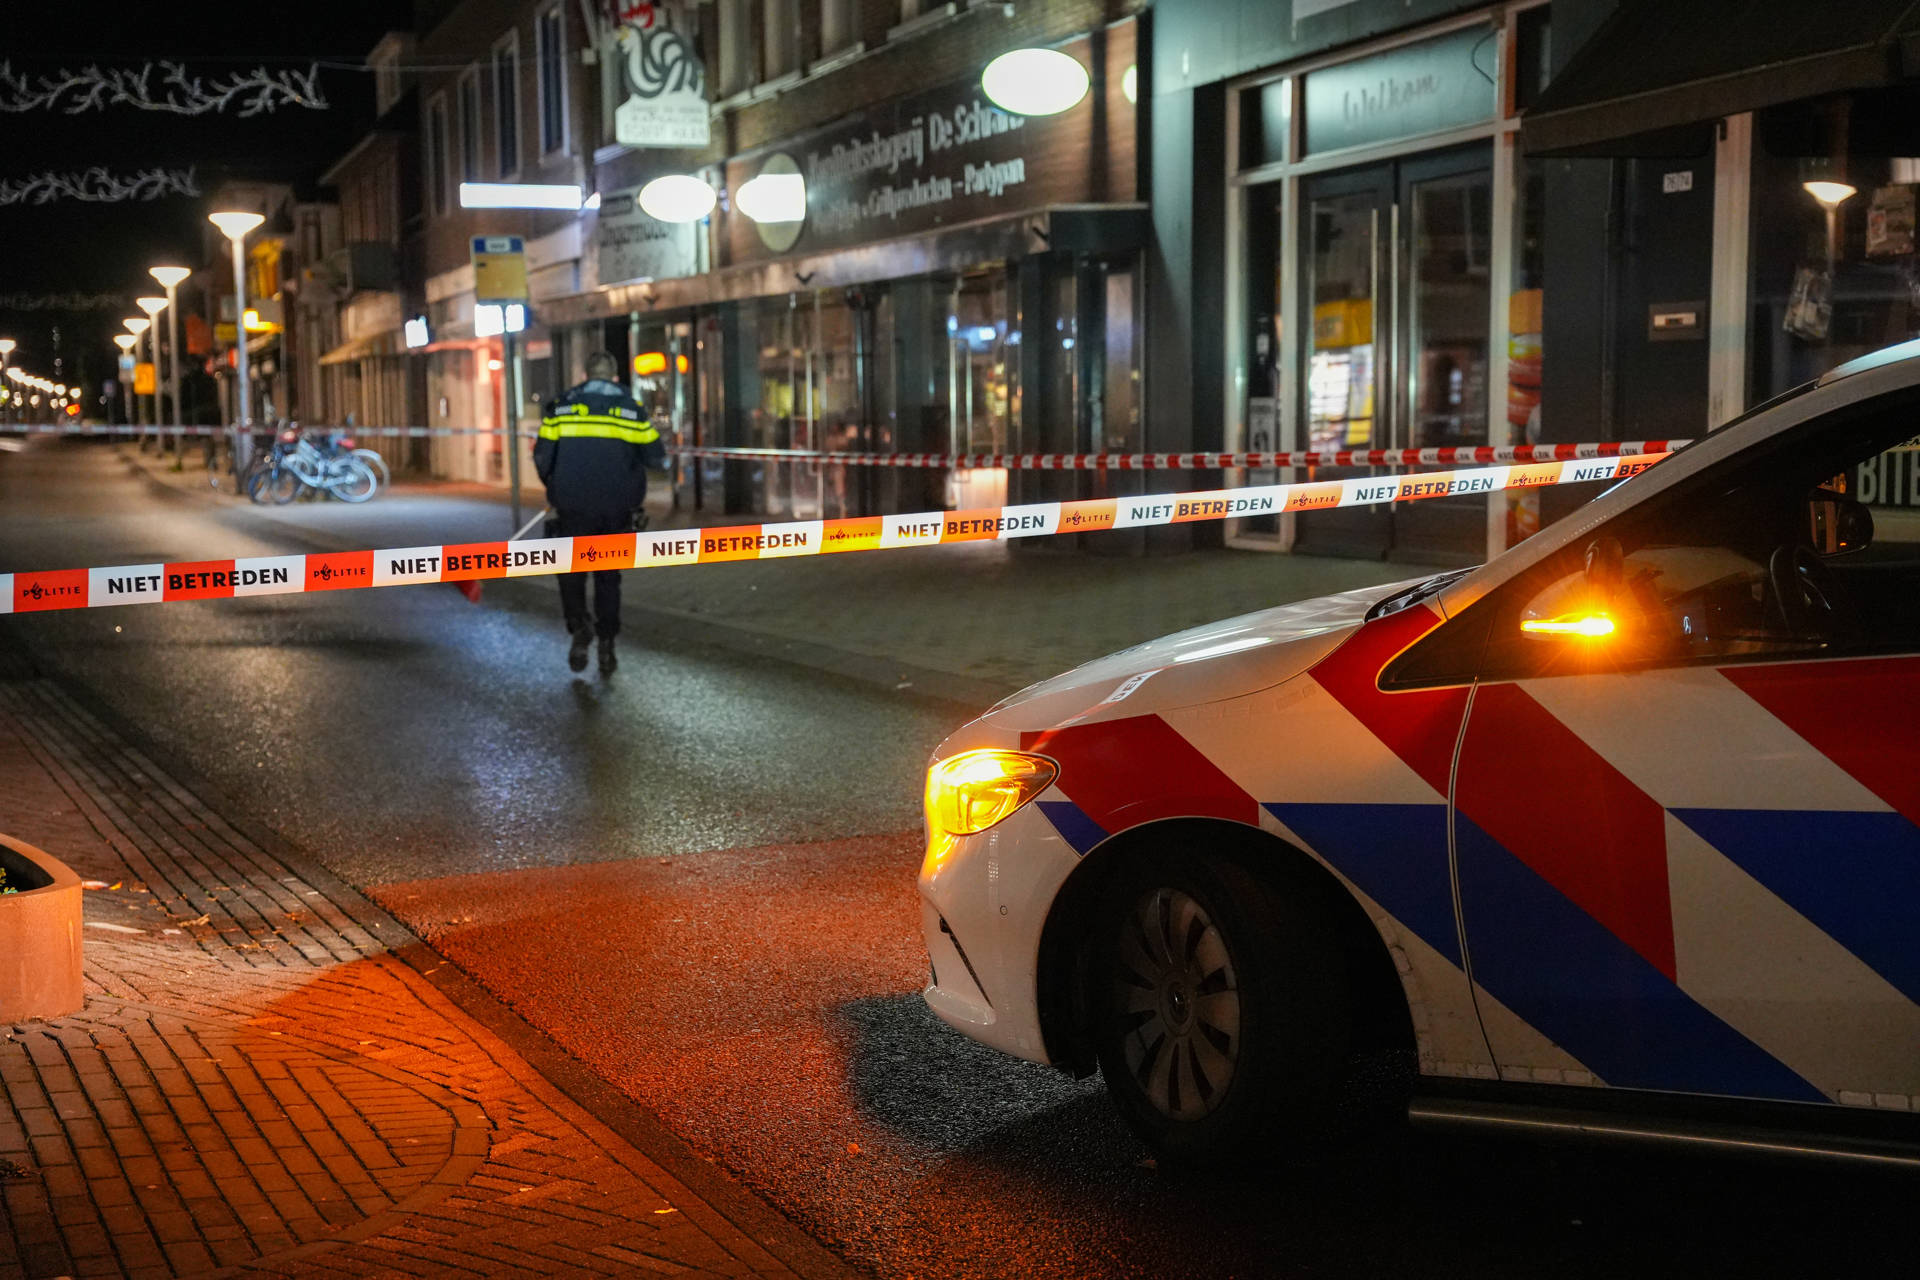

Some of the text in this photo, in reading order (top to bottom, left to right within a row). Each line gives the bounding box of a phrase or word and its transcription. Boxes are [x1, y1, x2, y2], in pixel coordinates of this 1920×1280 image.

[930, 113, 953, 150] De
[23, 582, 81, 599] POLITIE
[108, 575, 161, 594] NIET
[169, 567, 288, 590] BETREDEN
[314, 563, 366, 581] POLITIE
[391, 557, 440, 575] NIET
[447, 549, 556, 572] BETREDEN
[580, 545, 629, 562] POLITIE
[652, 540, 697, 557] NIET
[704, 532, 807, 553] BETREDEN
[829, 528, 876, 542] POLITIE
[898, 523, 941, 538] NIET
[947, 514, 1045, 535] BETREDEN
[1066, 511, 1111, 526] POLITIE
[1131, 505, 1173, 520] NIET
[1178, 497, 1273, 516] BETREDEN
[1293, 493, 1337, 507] POLITIE
[1356, 486, 1397, 501] NIET
[1402, 477, 1494, 497] BETREDEN
[1513, 473, 1555, 486] POLITIE
[1574, 466, 1615, 481] NIET
